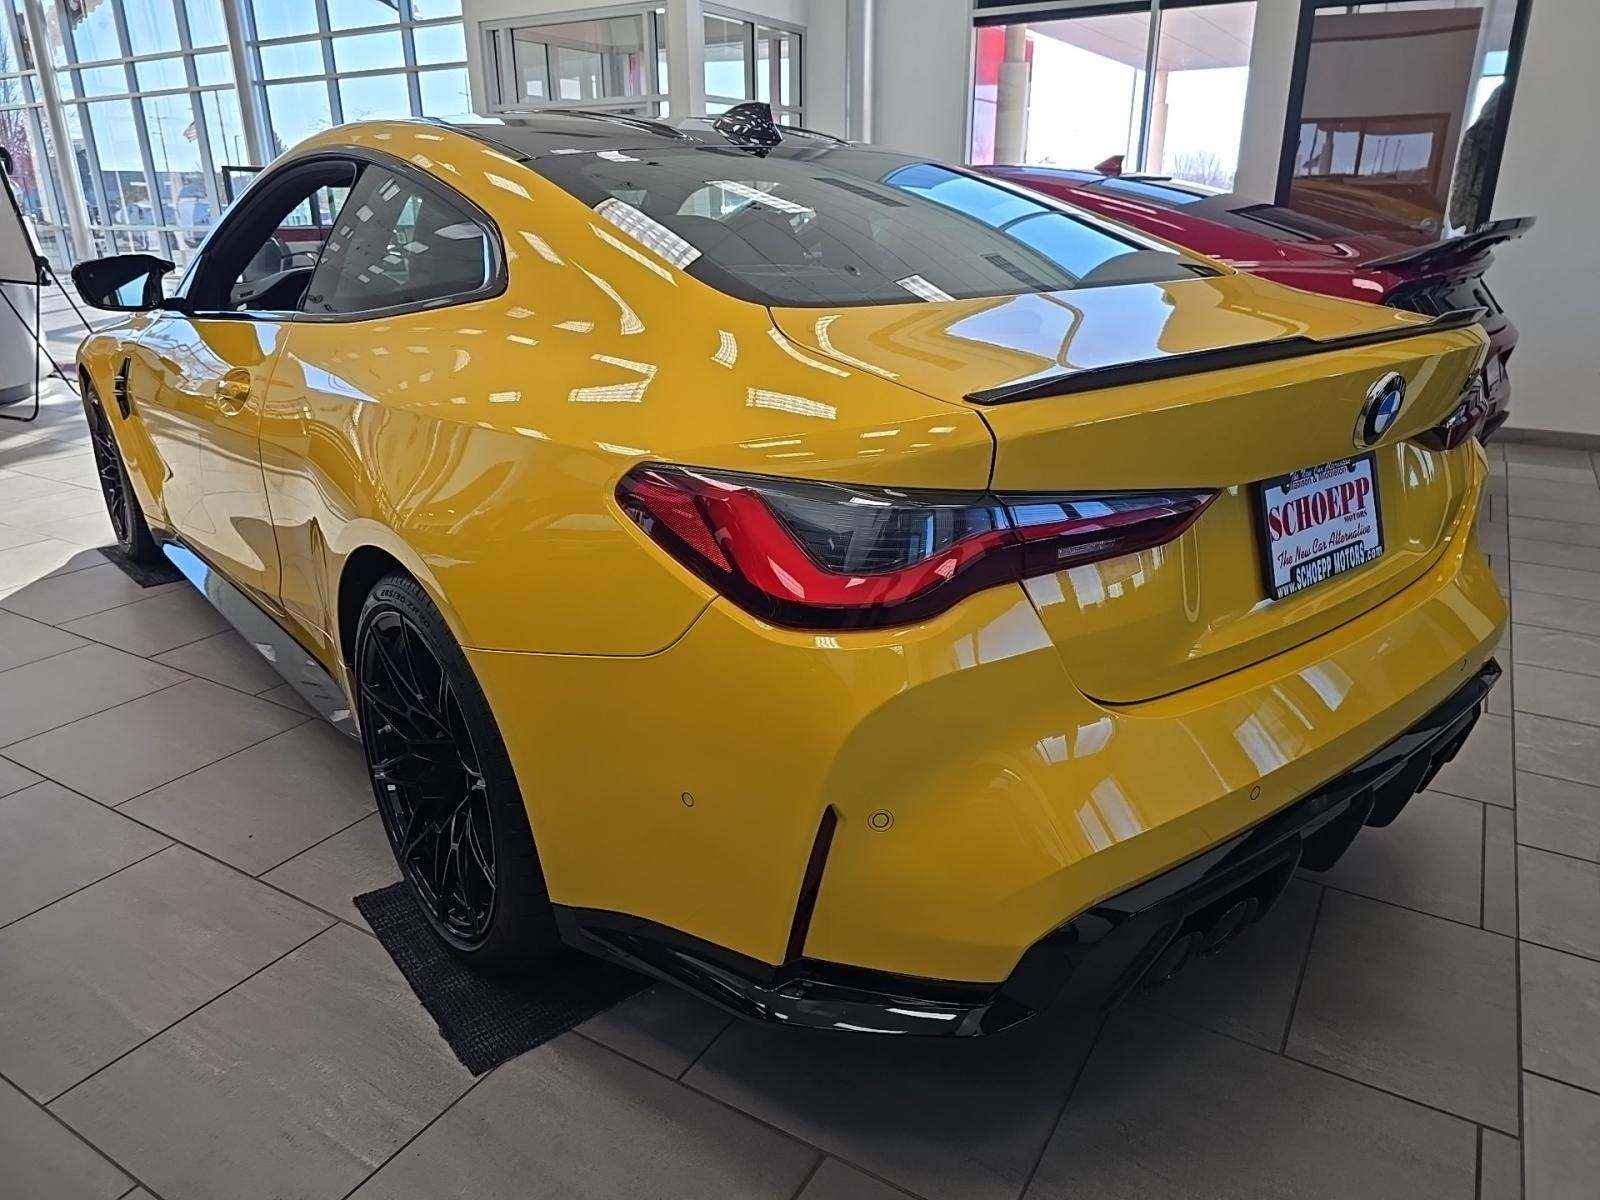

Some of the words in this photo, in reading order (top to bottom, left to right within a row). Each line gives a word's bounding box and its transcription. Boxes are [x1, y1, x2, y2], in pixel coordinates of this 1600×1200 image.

[1268, 476, 1370, 542] SCHOEPP
[1343, 510, 1368, 523] MOTORS
[1277, 549, 1293, 569] The
[1294, 545, 1311, 563] New
[1312, 538, 1327, 554] Car
[1328, 522, 1371, 548] Alternative
